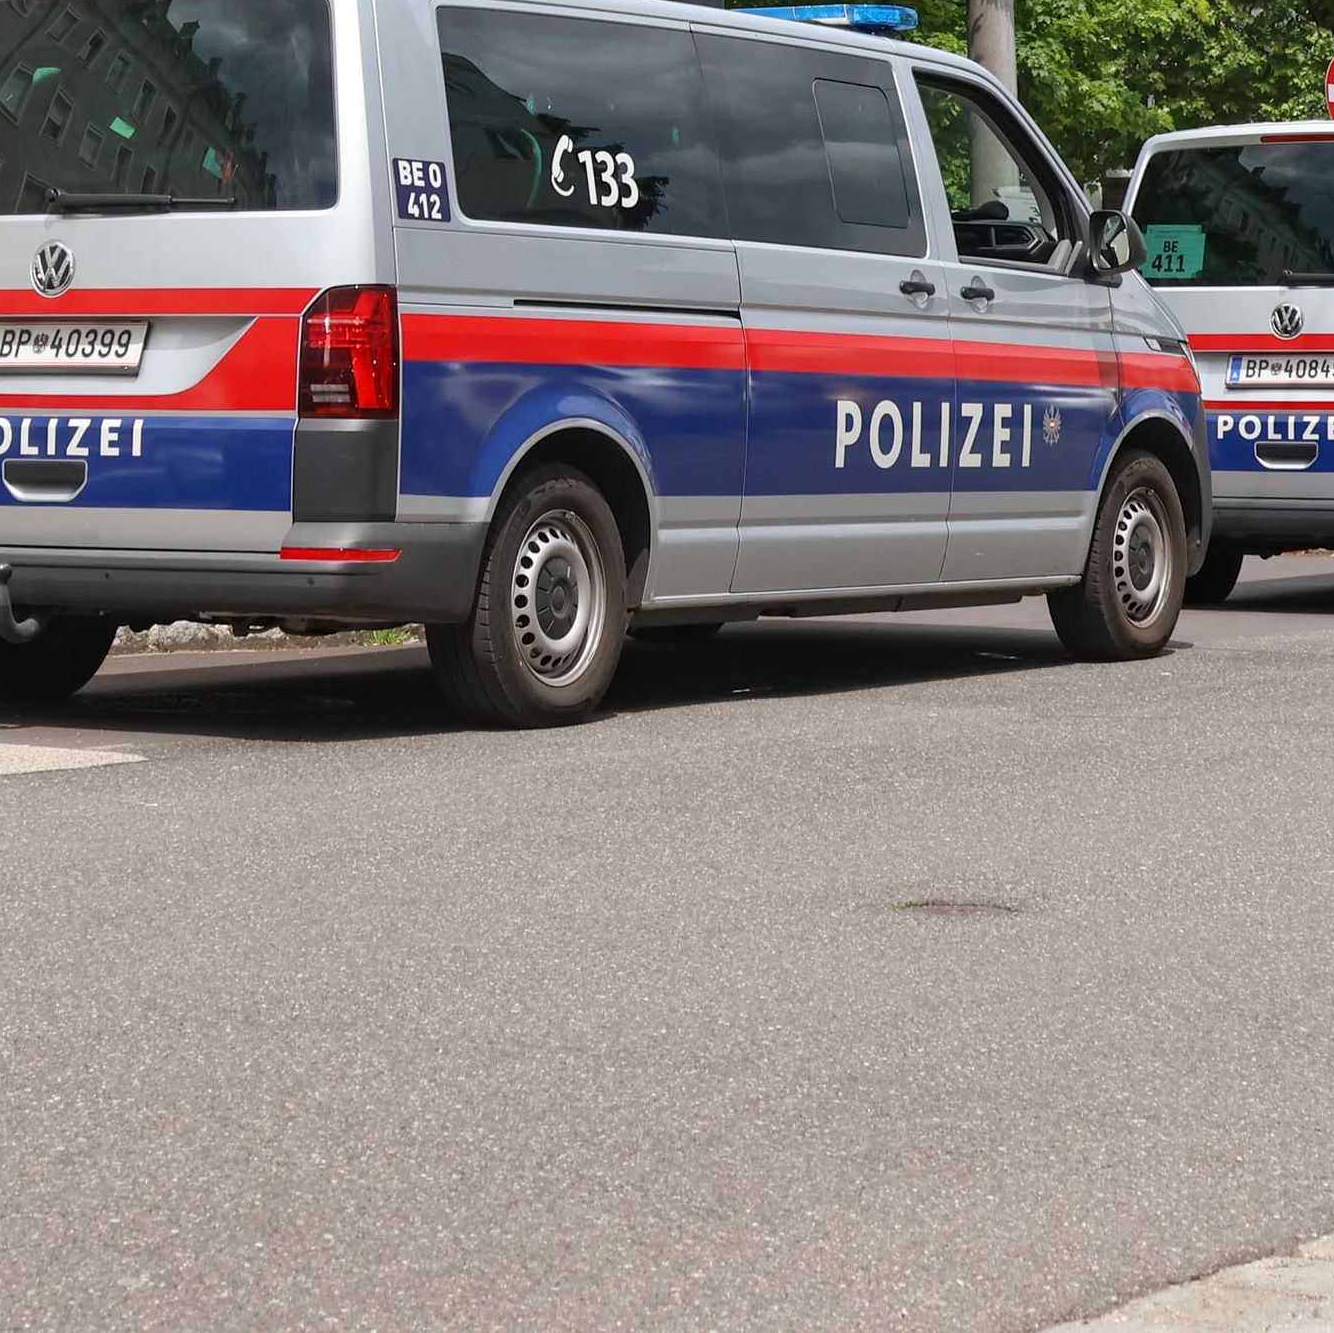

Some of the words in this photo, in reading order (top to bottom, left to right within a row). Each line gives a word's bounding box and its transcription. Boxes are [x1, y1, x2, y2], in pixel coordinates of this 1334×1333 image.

[398, 160, 426, 186] BE
[578, 150, 639, 208] 133
[407, 192, 442, 219] 412
[1163, 241, 1178, 252] BE
[1151, 254, 1185, 272] 411
[0, 329, 32, 358] BP
[50, 329, 132, 358] 40399
[1245, 359, 1269, 378] BP
[834, 400, 1033, 469] POLIZEI
